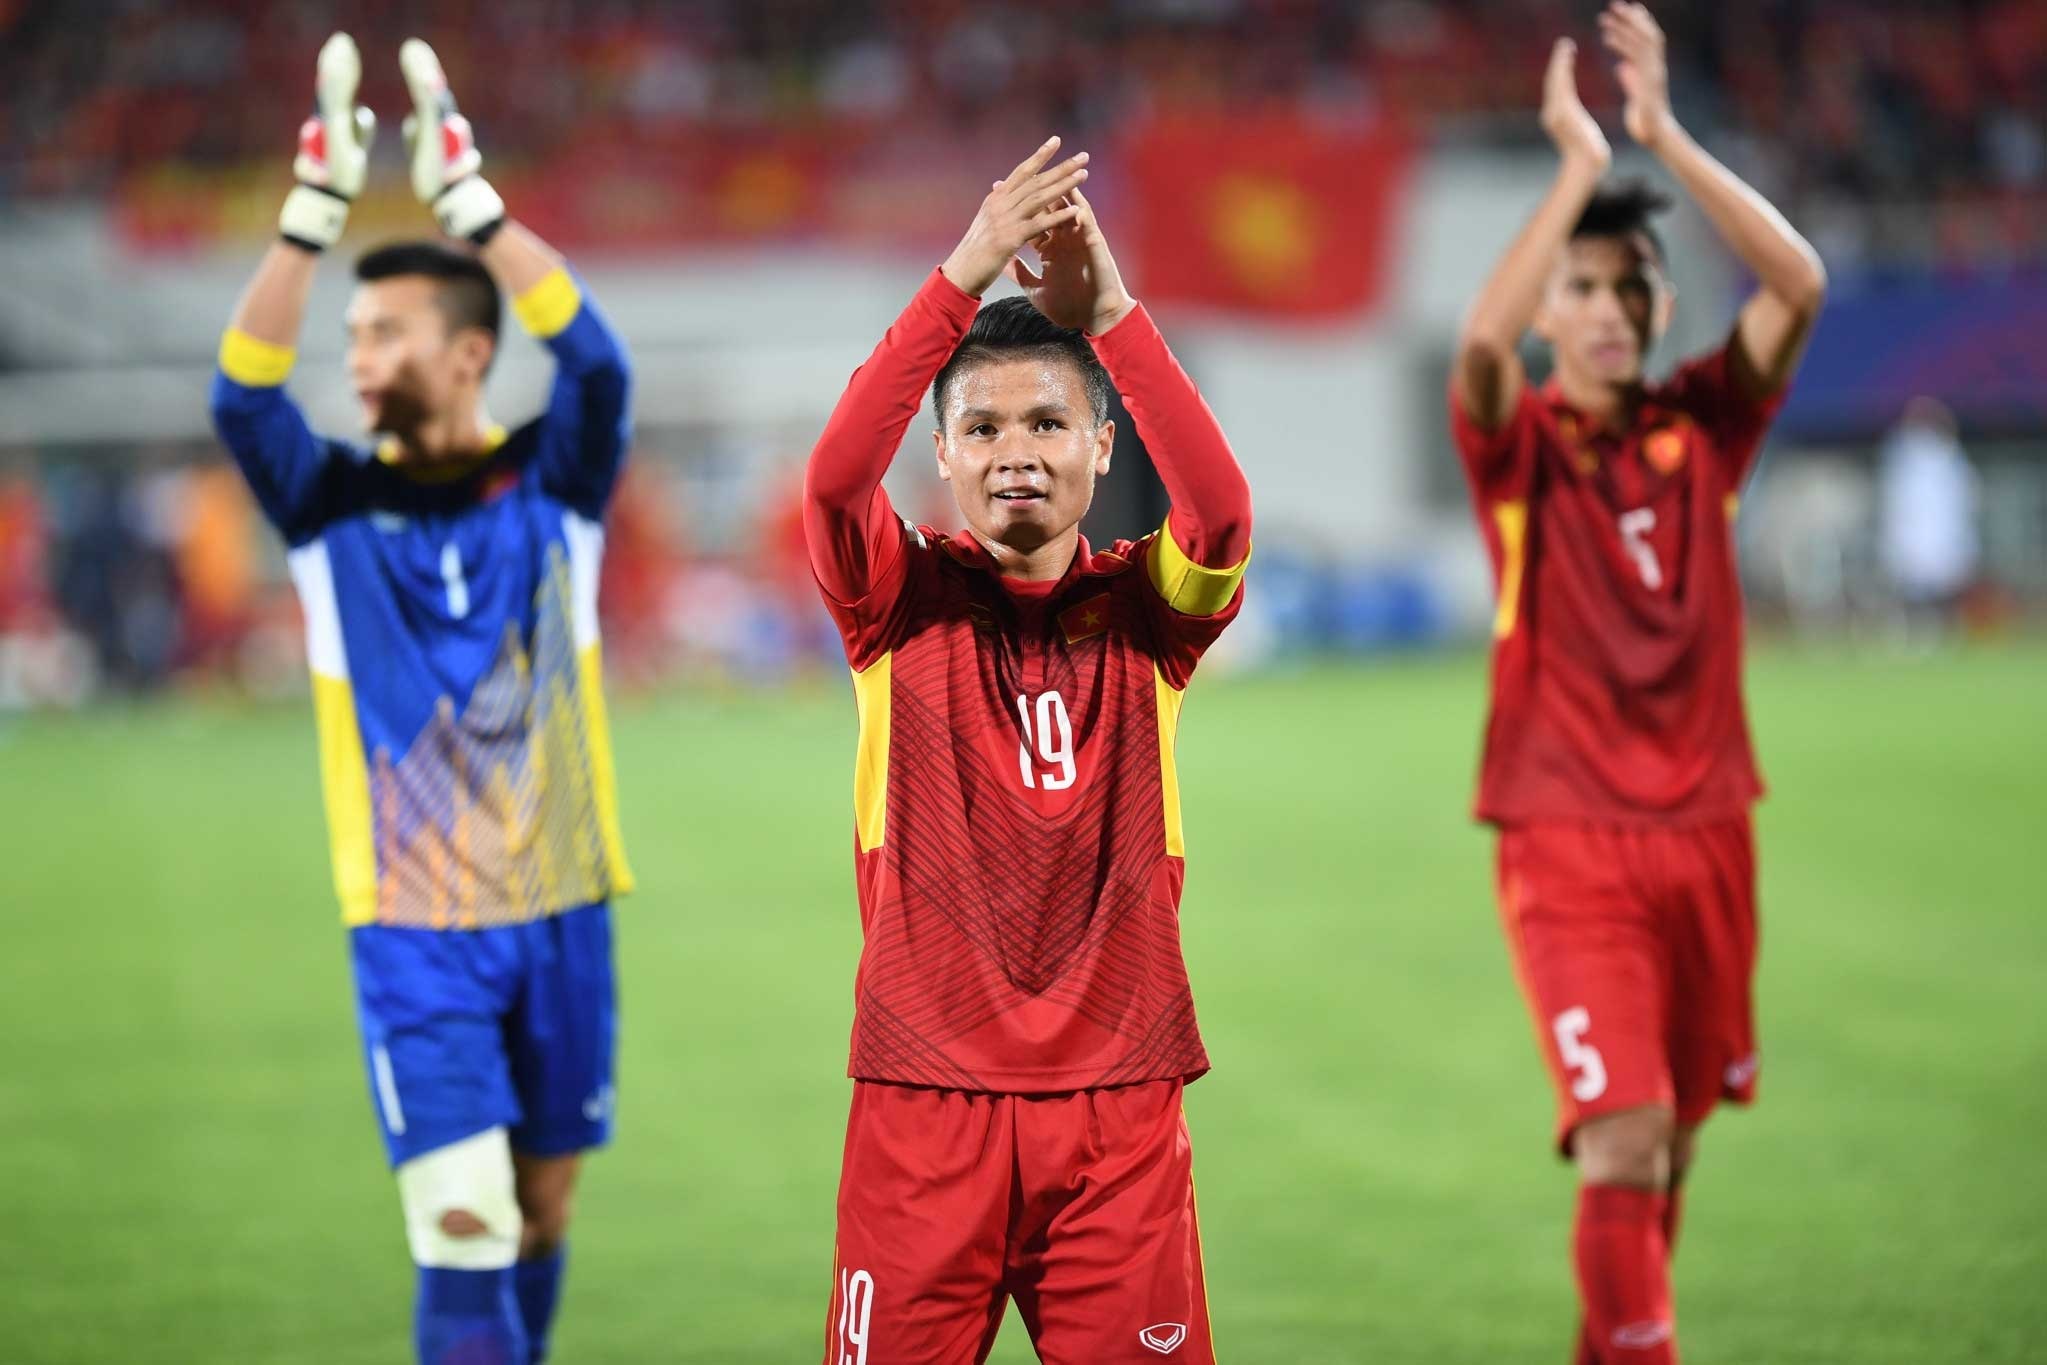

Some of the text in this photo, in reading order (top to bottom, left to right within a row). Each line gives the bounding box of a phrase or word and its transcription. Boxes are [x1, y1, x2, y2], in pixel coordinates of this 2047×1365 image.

[440, 541, 470, 620] 1
[1017, 690, 1077, 790] 19
[1552, 1005, 1608, 1103] 5
[838, 1266, 874, 1365] 19
